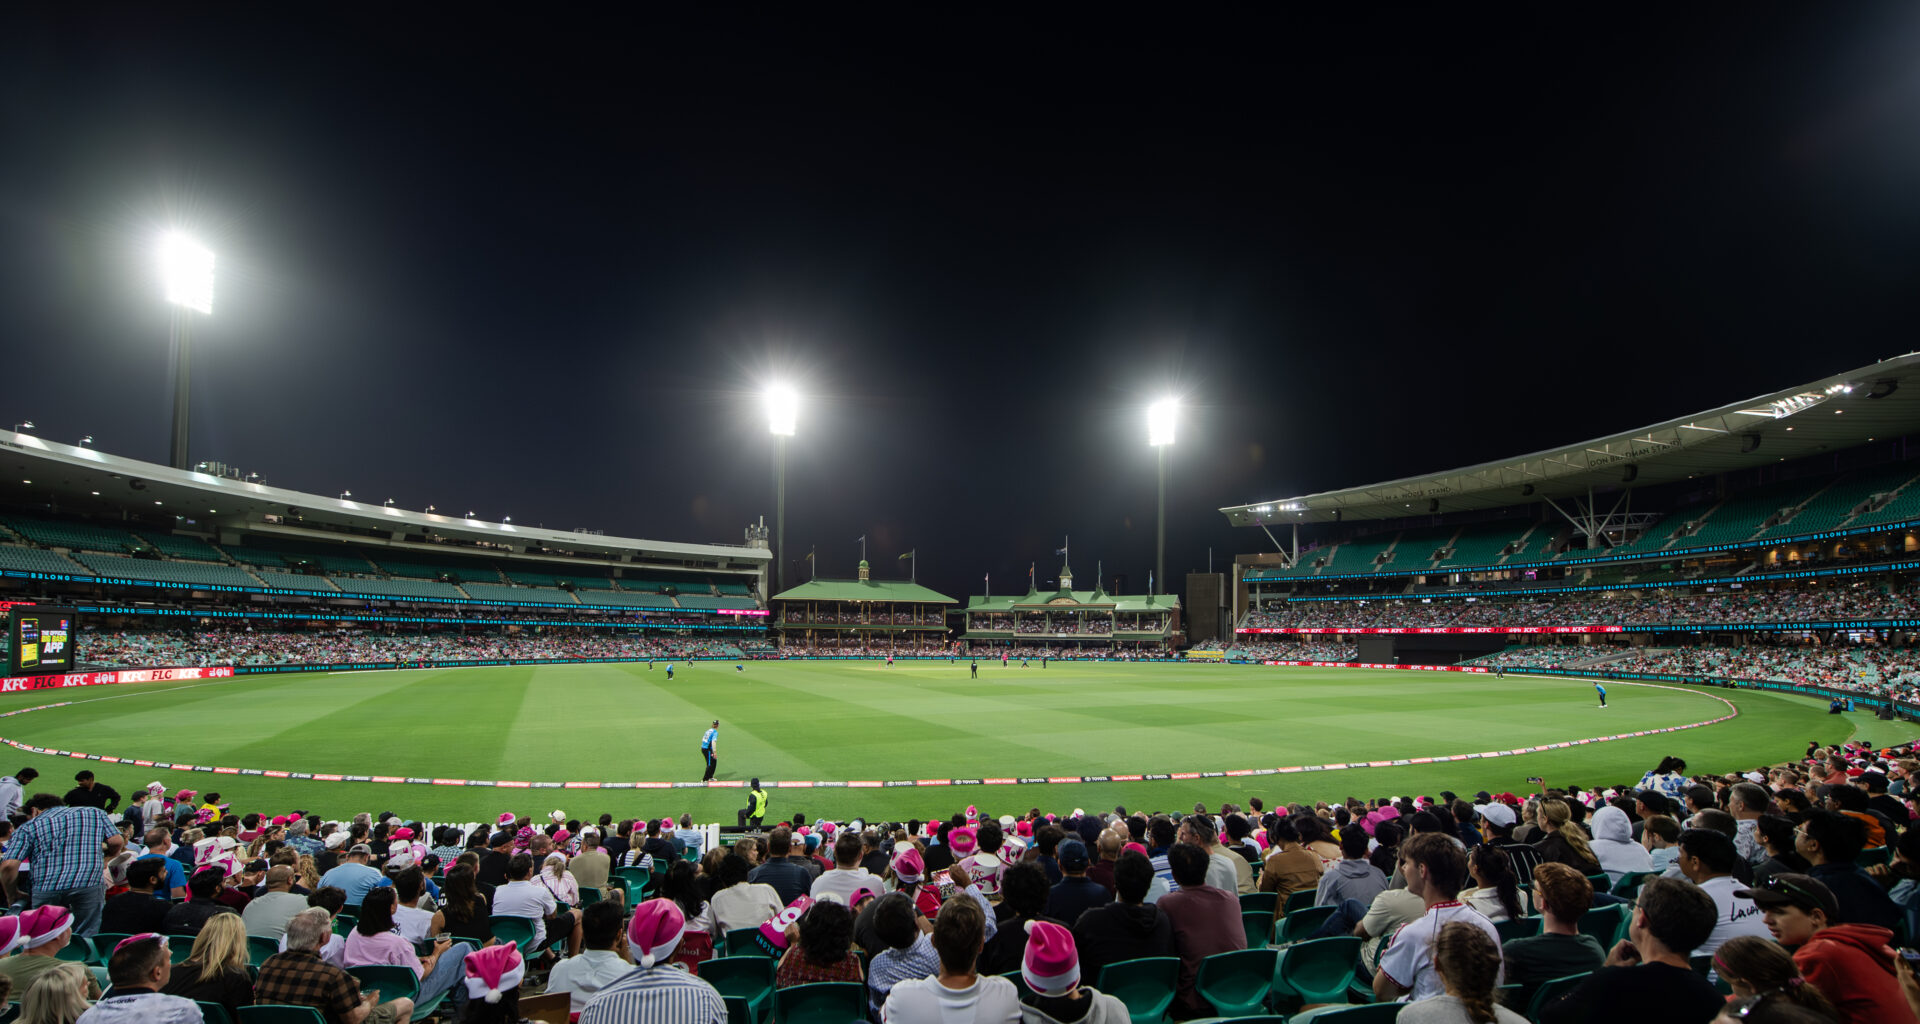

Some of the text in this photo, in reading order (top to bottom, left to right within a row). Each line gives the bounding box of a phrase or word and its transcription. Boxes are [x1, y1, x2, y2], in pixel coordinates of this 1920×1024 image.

[1590, 457, 1608, 467] DON
[44, 642, 64, 653] APP
[2, 678, 28, 692] KFC
[34, 676, 55, 688] FLG
[63, 674, 88, 686] KFC
[152, 670, 172, 680] FLG
[179, 668, 202, 678] KFC
